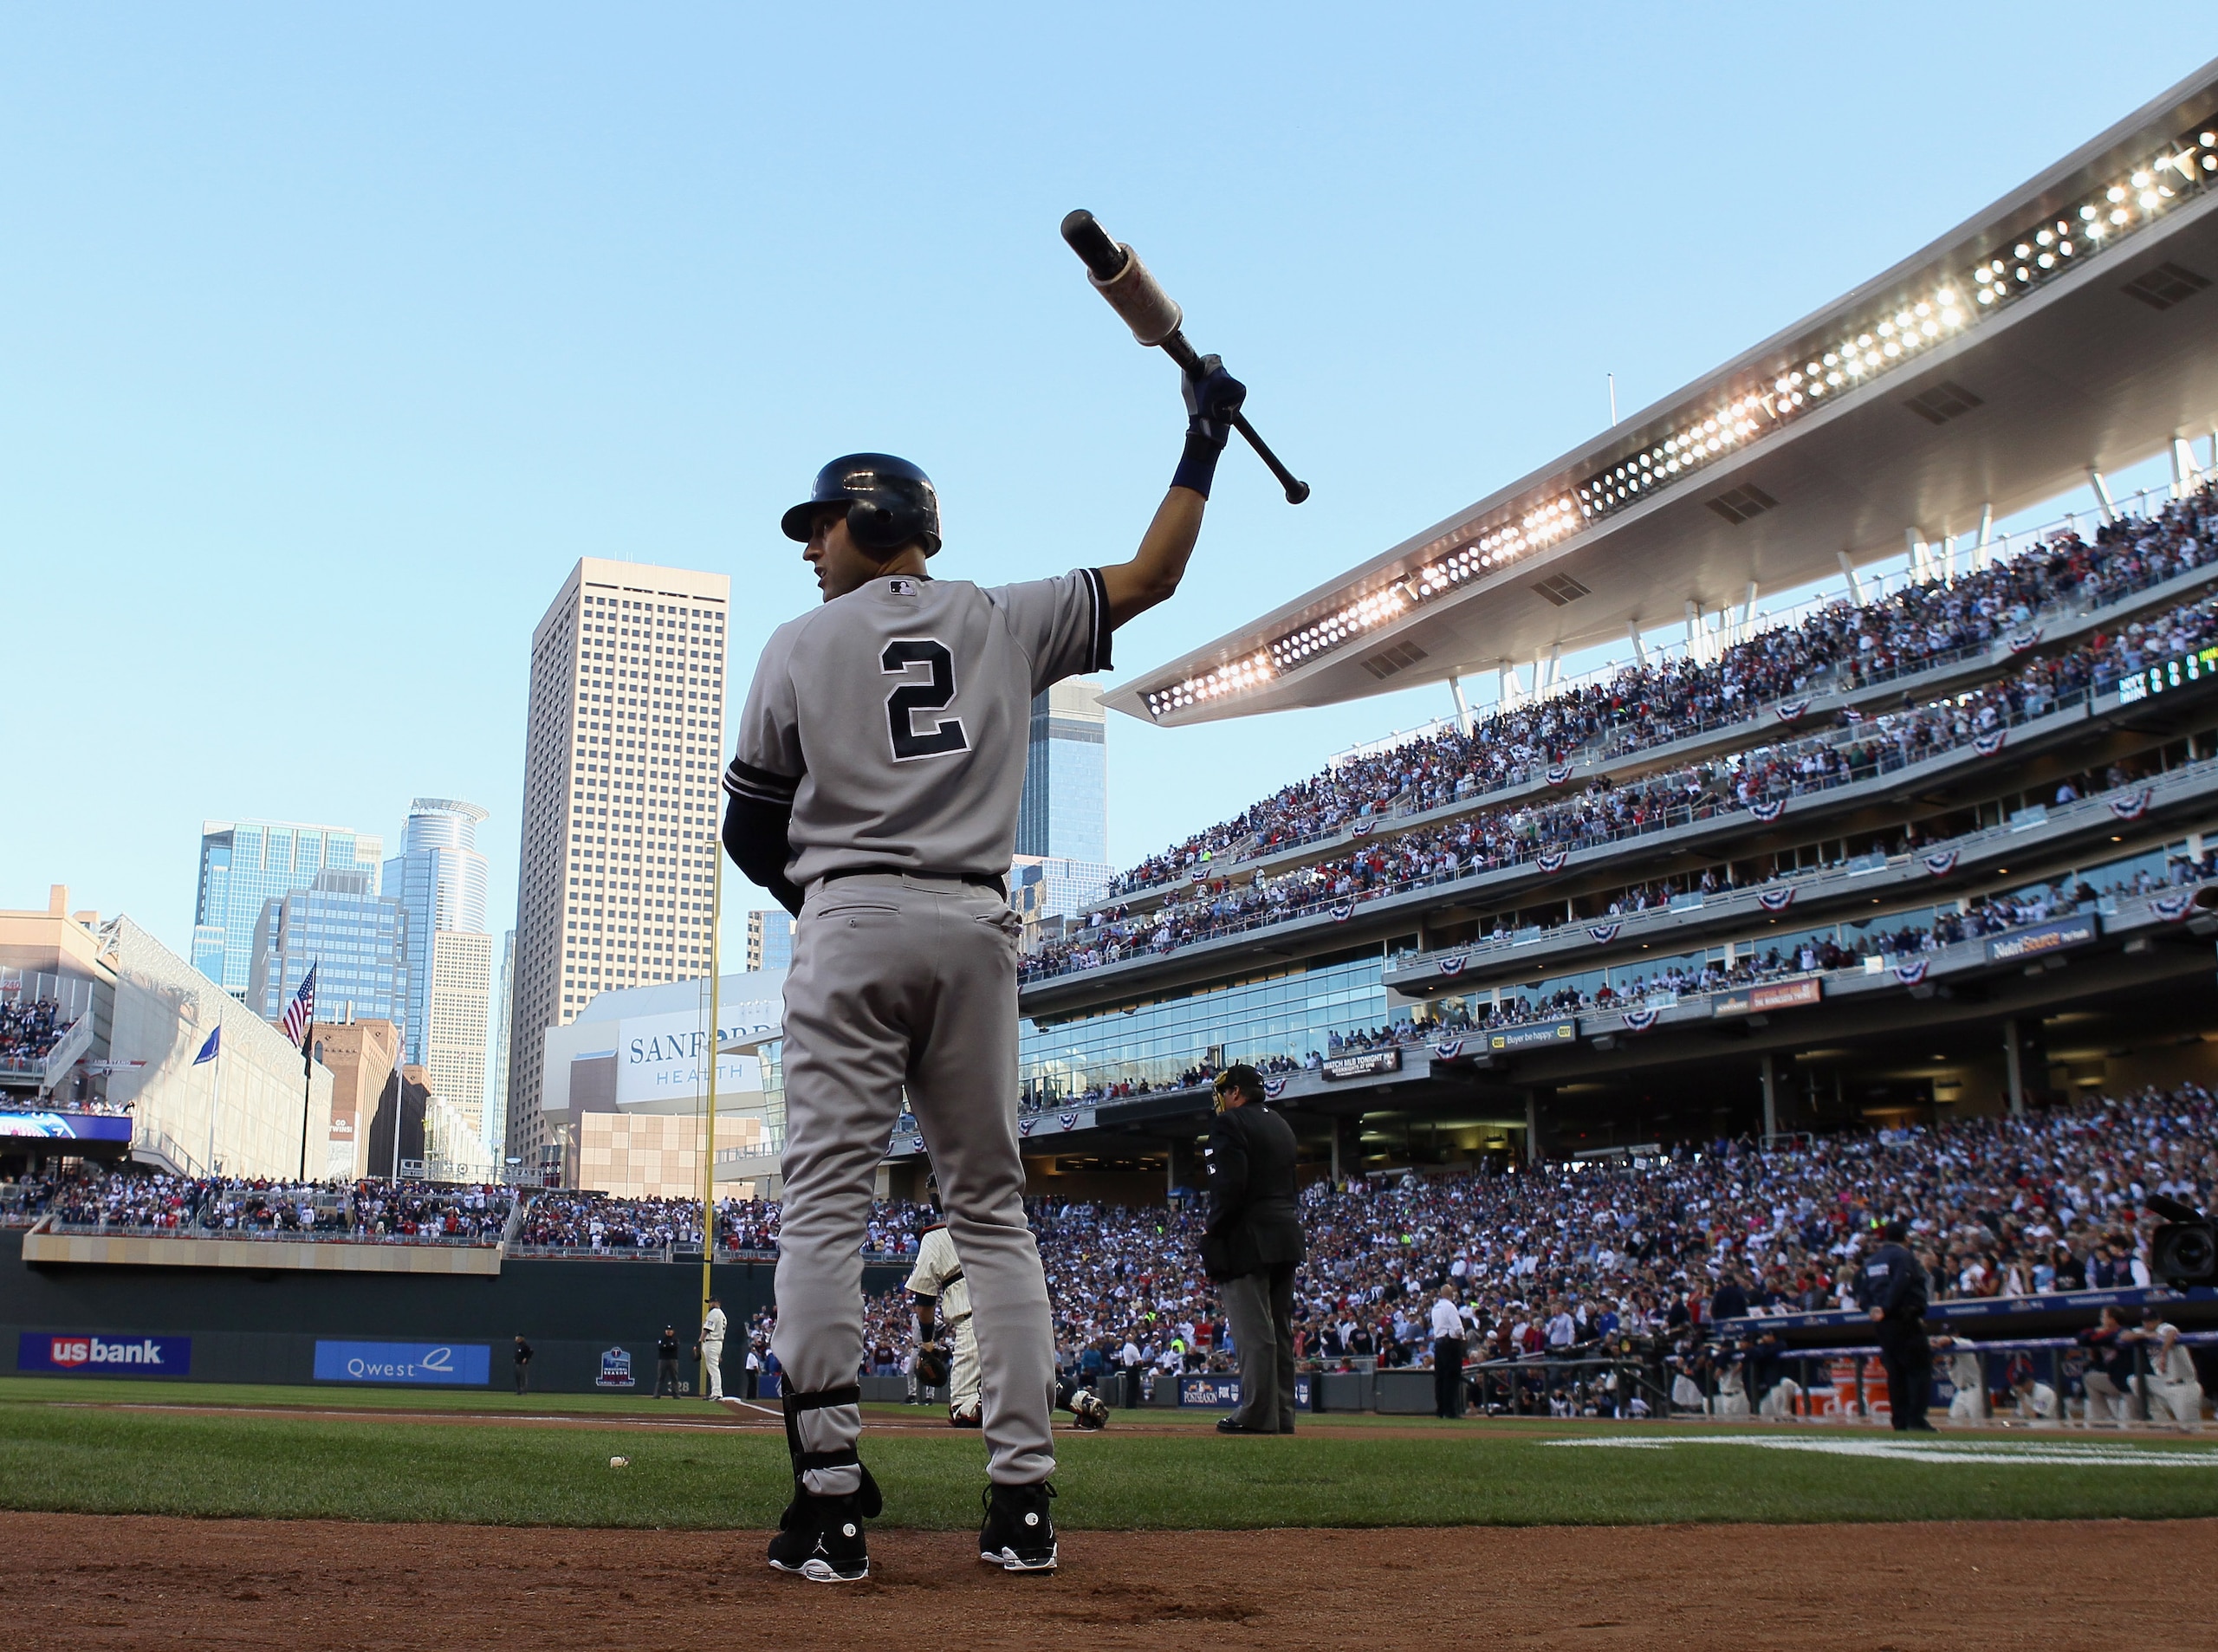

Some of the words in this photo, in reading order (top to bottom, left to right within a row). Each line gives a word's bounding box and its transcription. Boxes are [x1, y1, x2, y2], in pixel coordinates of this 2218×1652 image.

[878, 637, 972, 762] 2
[630, 1024, 771, 1064] SANF
[1508, 1035, 1525, 1045] Buyer
[1323, 1059, 1344, 1070] WATCH
[1344, 1057, 1357, 1066] MLB
[1357, 1053, 1383, 1065] TONIGHT
[347, 1357, 415, 1378] Qwest
[1184, 1390, 1217, 1403] POSTSEASON
[1219, 1386, 1229, 1399] FOX
